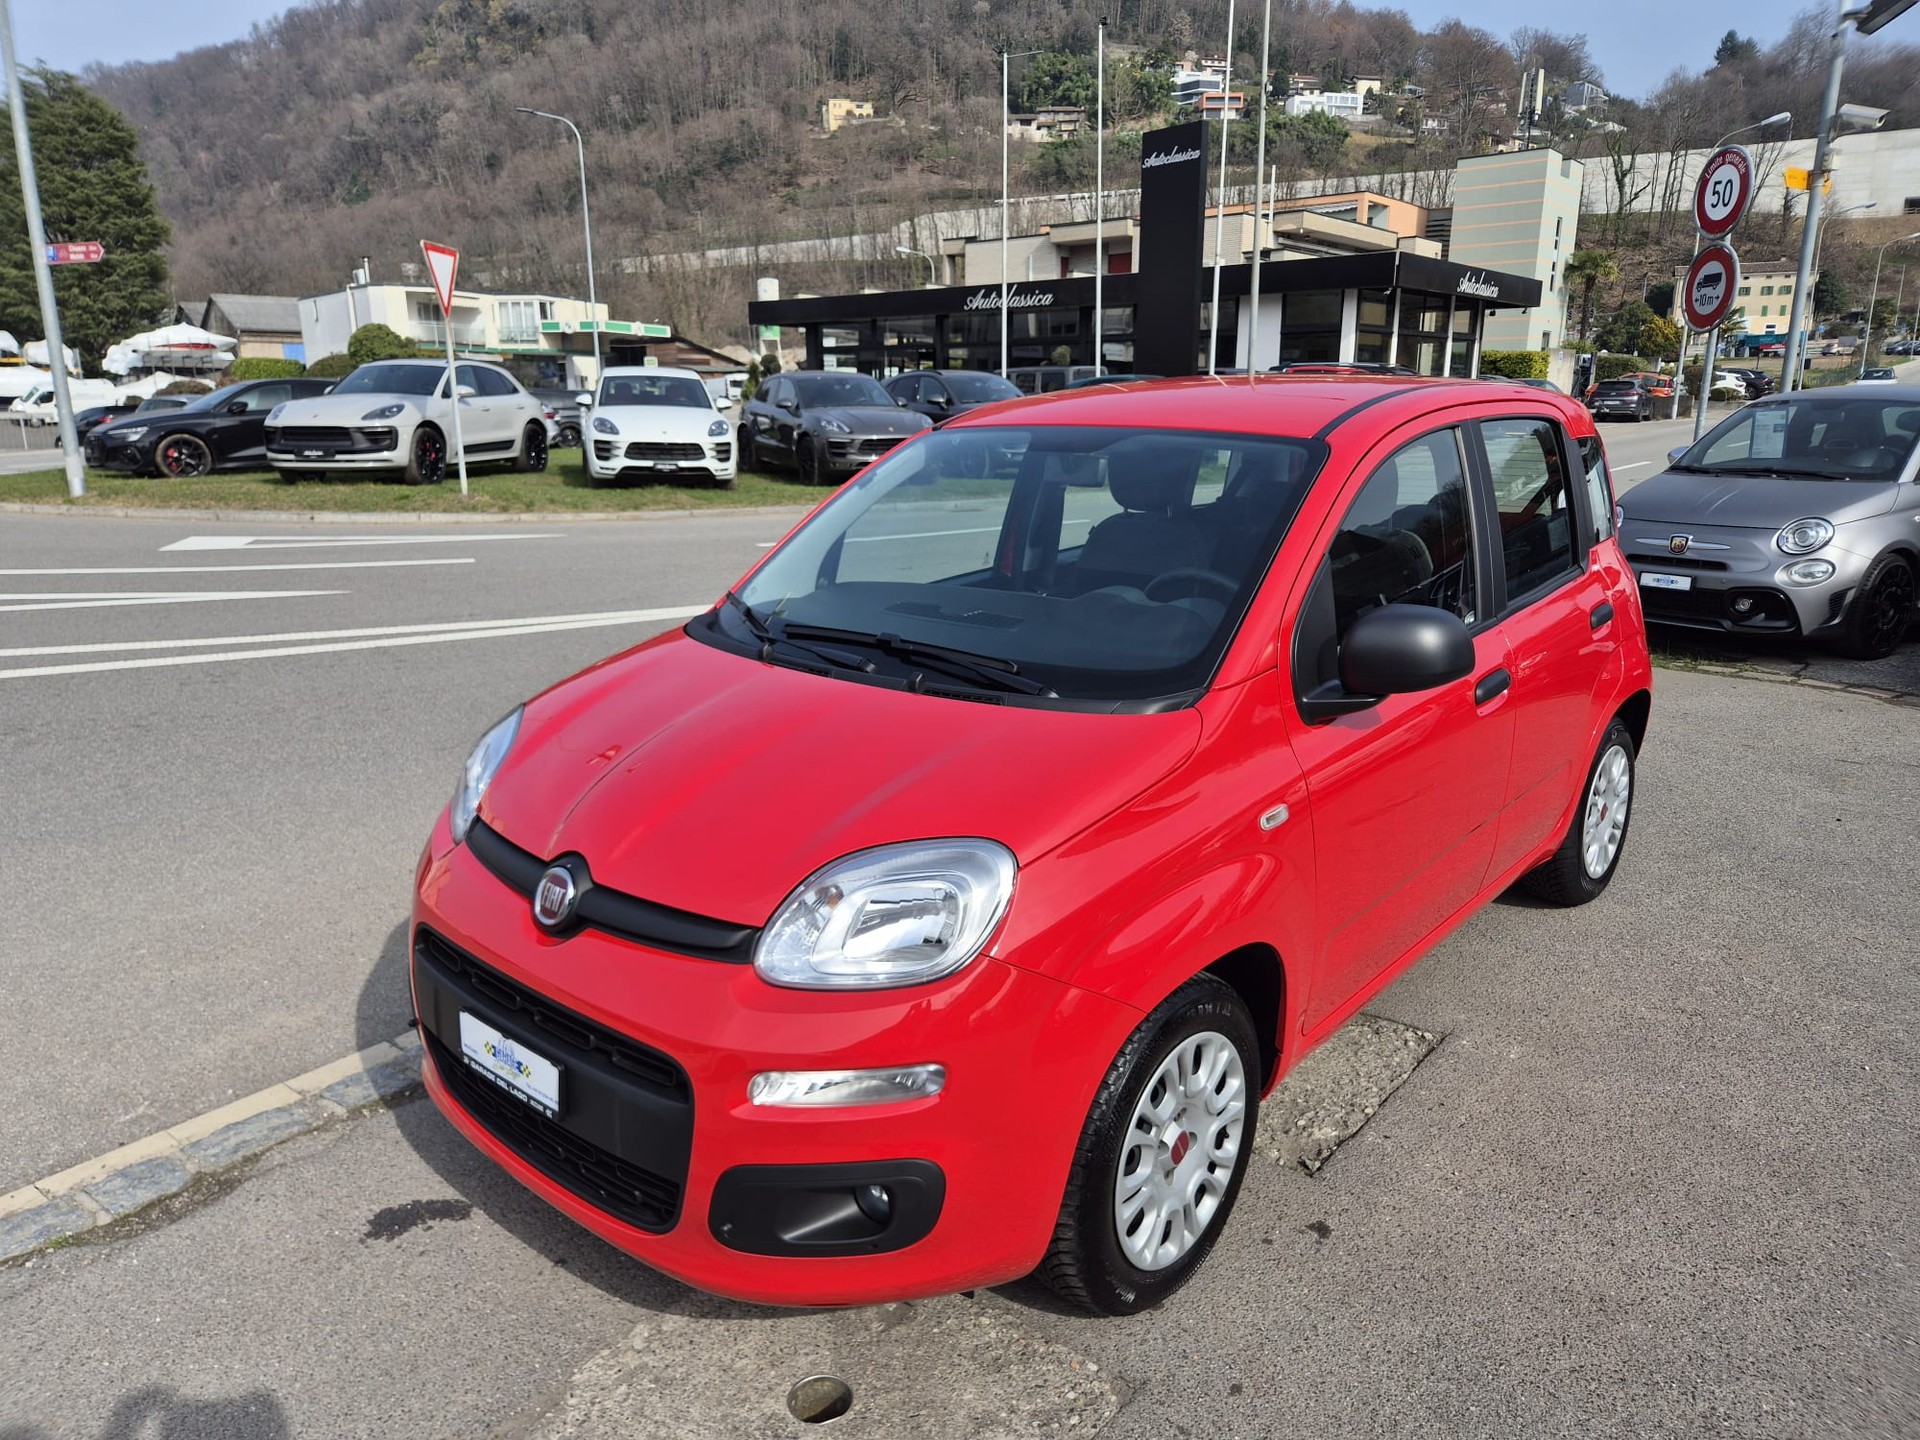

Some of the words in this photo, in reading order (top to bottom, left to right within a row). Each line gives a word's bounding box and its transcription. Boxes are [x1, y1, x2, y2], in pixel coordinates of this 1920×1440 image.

[1142, 145, 1201, 168] Autoclassica
[1705, 156, 1723, 179] Limite
[1725, 153, 1747, 175] generale
[1711, 178, 1733, 209] 50
[1456, 270, 1499, 298] Autoclassica
[542, 882, 567, 912] FIAT
